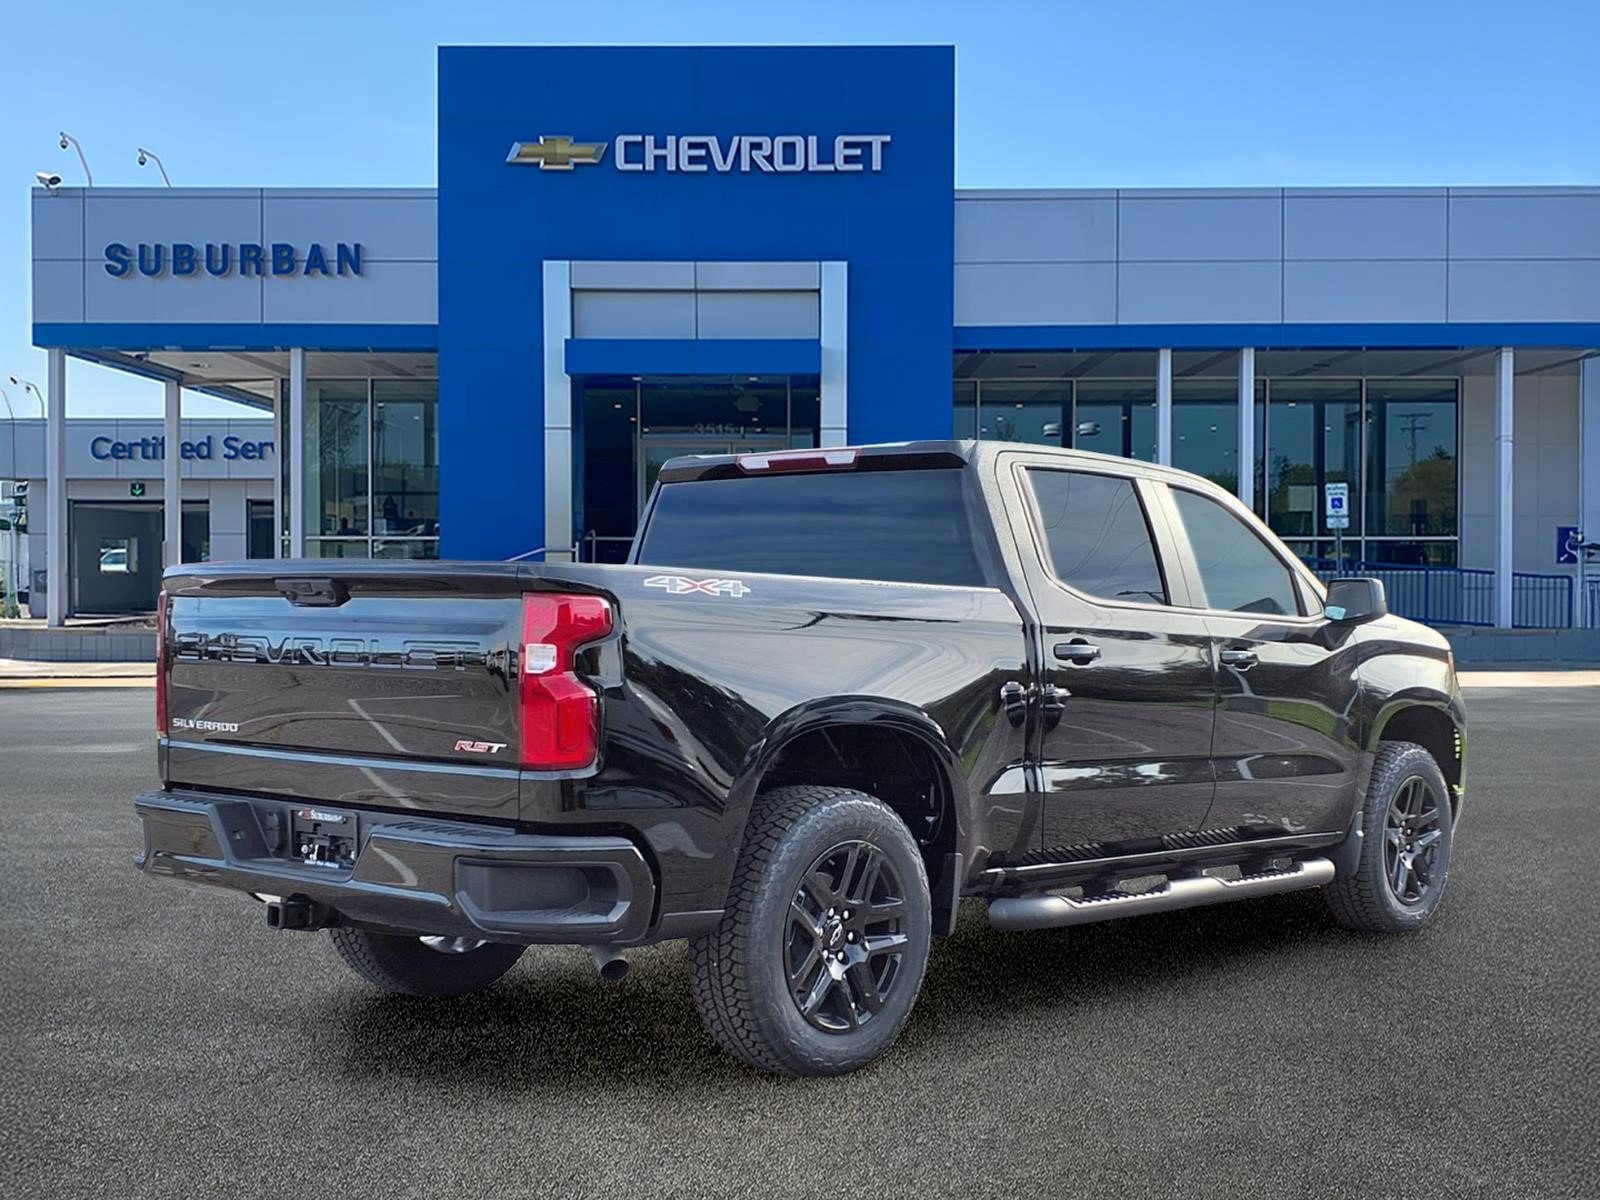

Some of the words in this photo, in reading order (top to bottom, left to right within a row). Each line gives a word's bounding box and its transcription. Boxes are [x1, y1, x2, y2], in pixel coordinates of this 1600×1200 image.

[614, 134, 892, 172] CHEVROLET
[103, 242, 363, 277] SUBURBAN
[91, 435, 212, 460] Certifed
[172, 717, 239, 732] SILVERADO
[454, 740, 508, 753] RST
